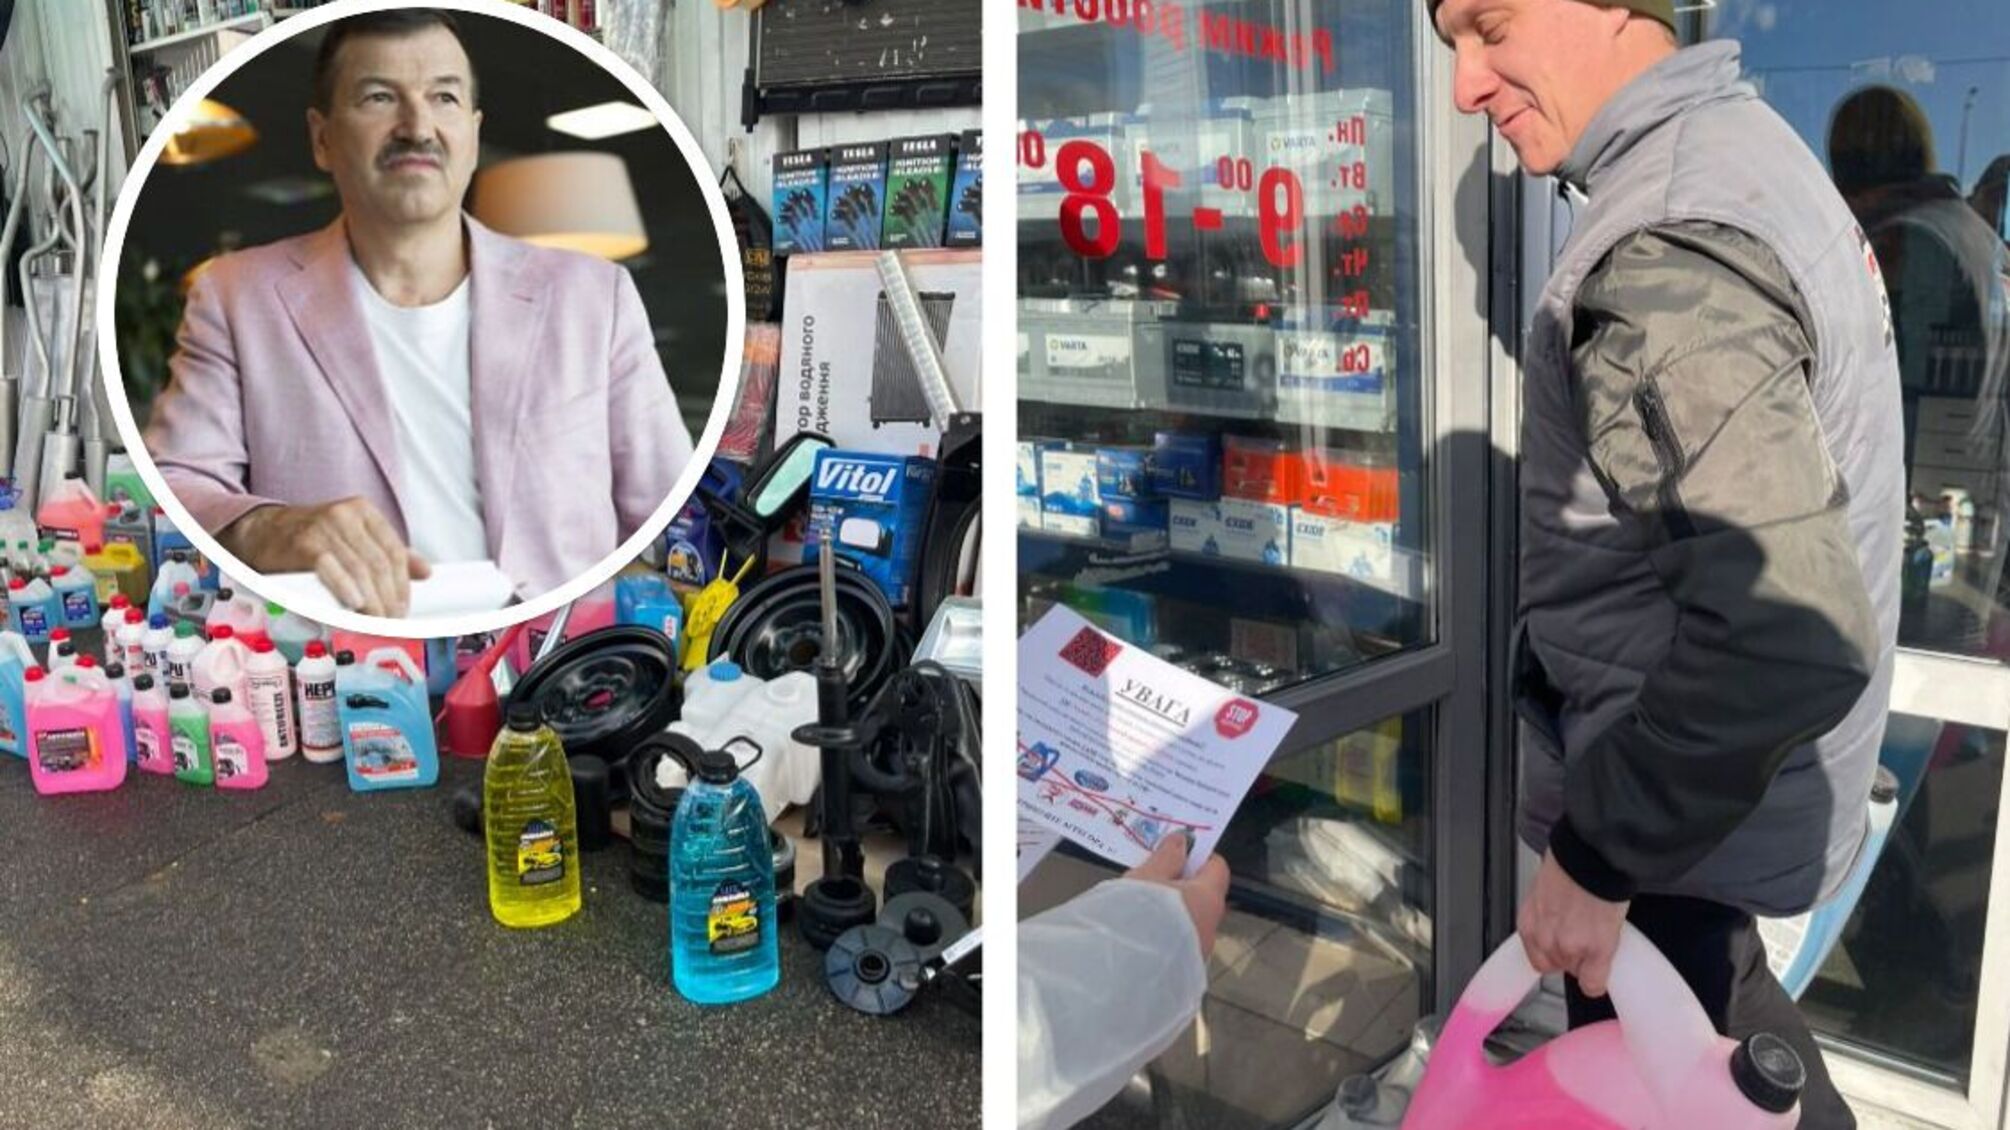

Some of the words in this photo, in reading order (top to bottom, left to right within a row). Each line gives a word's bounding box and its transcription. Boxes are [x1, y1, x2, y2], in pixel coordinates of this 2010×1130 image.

[843, 147, 875, 159] TESLA
[903, 139, 937, 152] TESLA
[799, 314, 816, 400] водяного
[817, 458, 898, 494] Vitol
[1120, 678, 1192, 724] УВАГА
